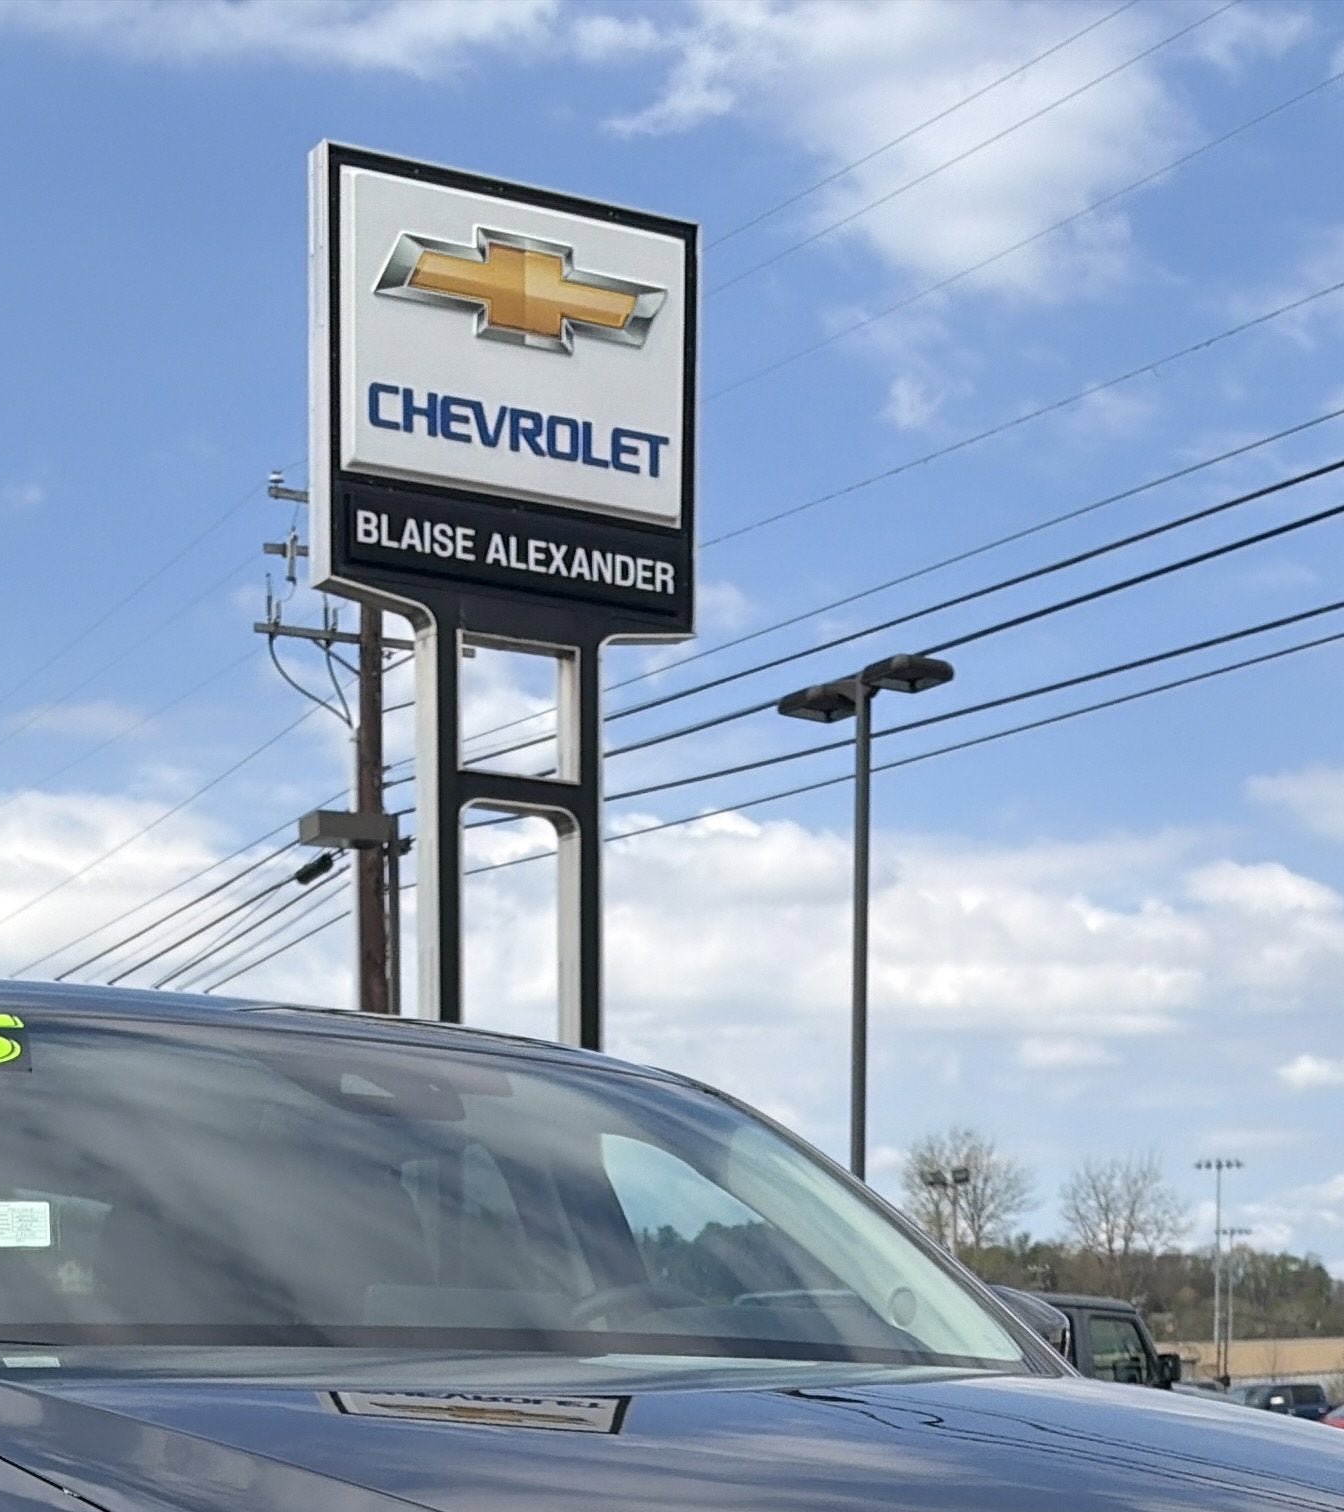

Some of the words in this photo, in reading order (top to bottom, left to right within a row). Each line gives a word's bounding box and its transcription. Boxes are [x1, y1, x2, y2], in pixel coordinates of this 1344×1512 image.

[367, 381, 670, 478] CHEVROLET
[355, 509, 476, 562] BLAISE
[485, 531, 675, 595] ALEXANDER
